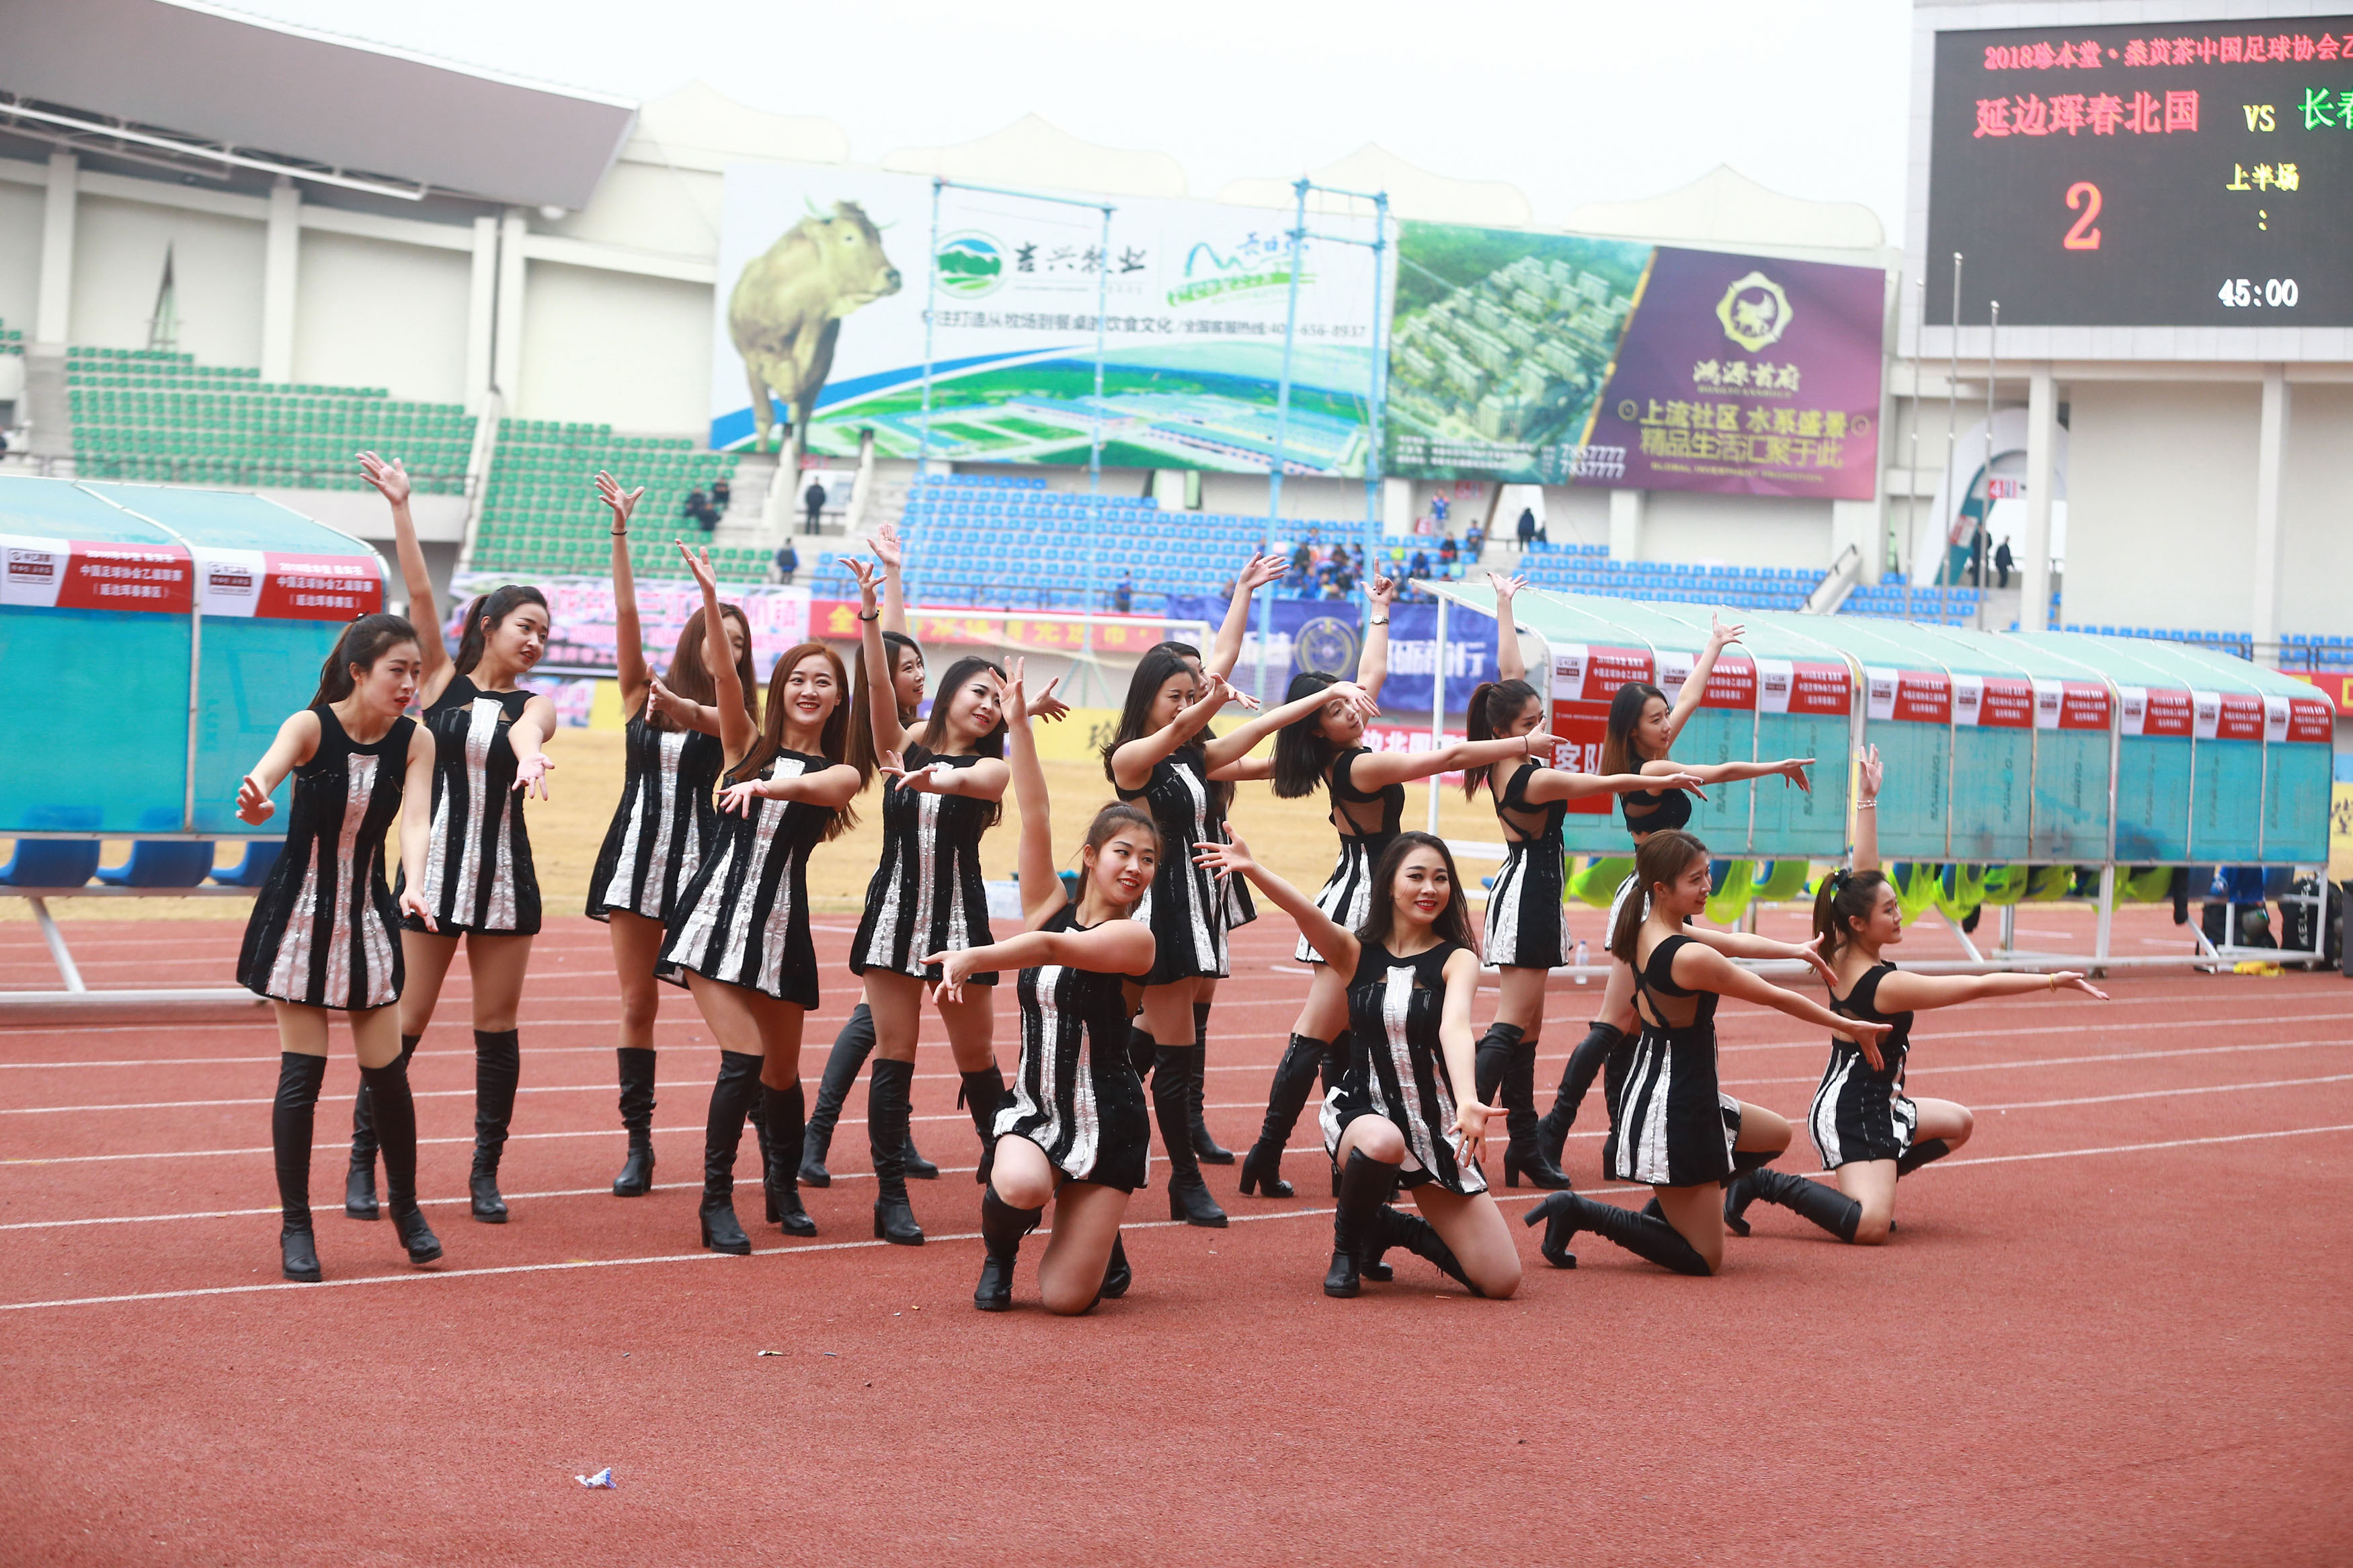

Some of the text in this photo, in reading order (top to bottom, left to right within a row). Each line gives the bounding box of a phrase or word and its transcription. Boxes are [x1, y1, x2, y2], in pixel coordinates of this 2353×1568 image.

[1973, 89, 2200, 138] 延边珲春北国
[2226, 163, 2299, 192] 上半场
[2063, 181, 2102, 249] 2
[2218, 278, 2299, 307] 45:00
[1693, 359, 1800, 392] 鸿源首府
[1640, 399, 1848, 438] 上流社区 水系盛景
[1640, 427, 1844, 469] 精品生活汇聚于此
